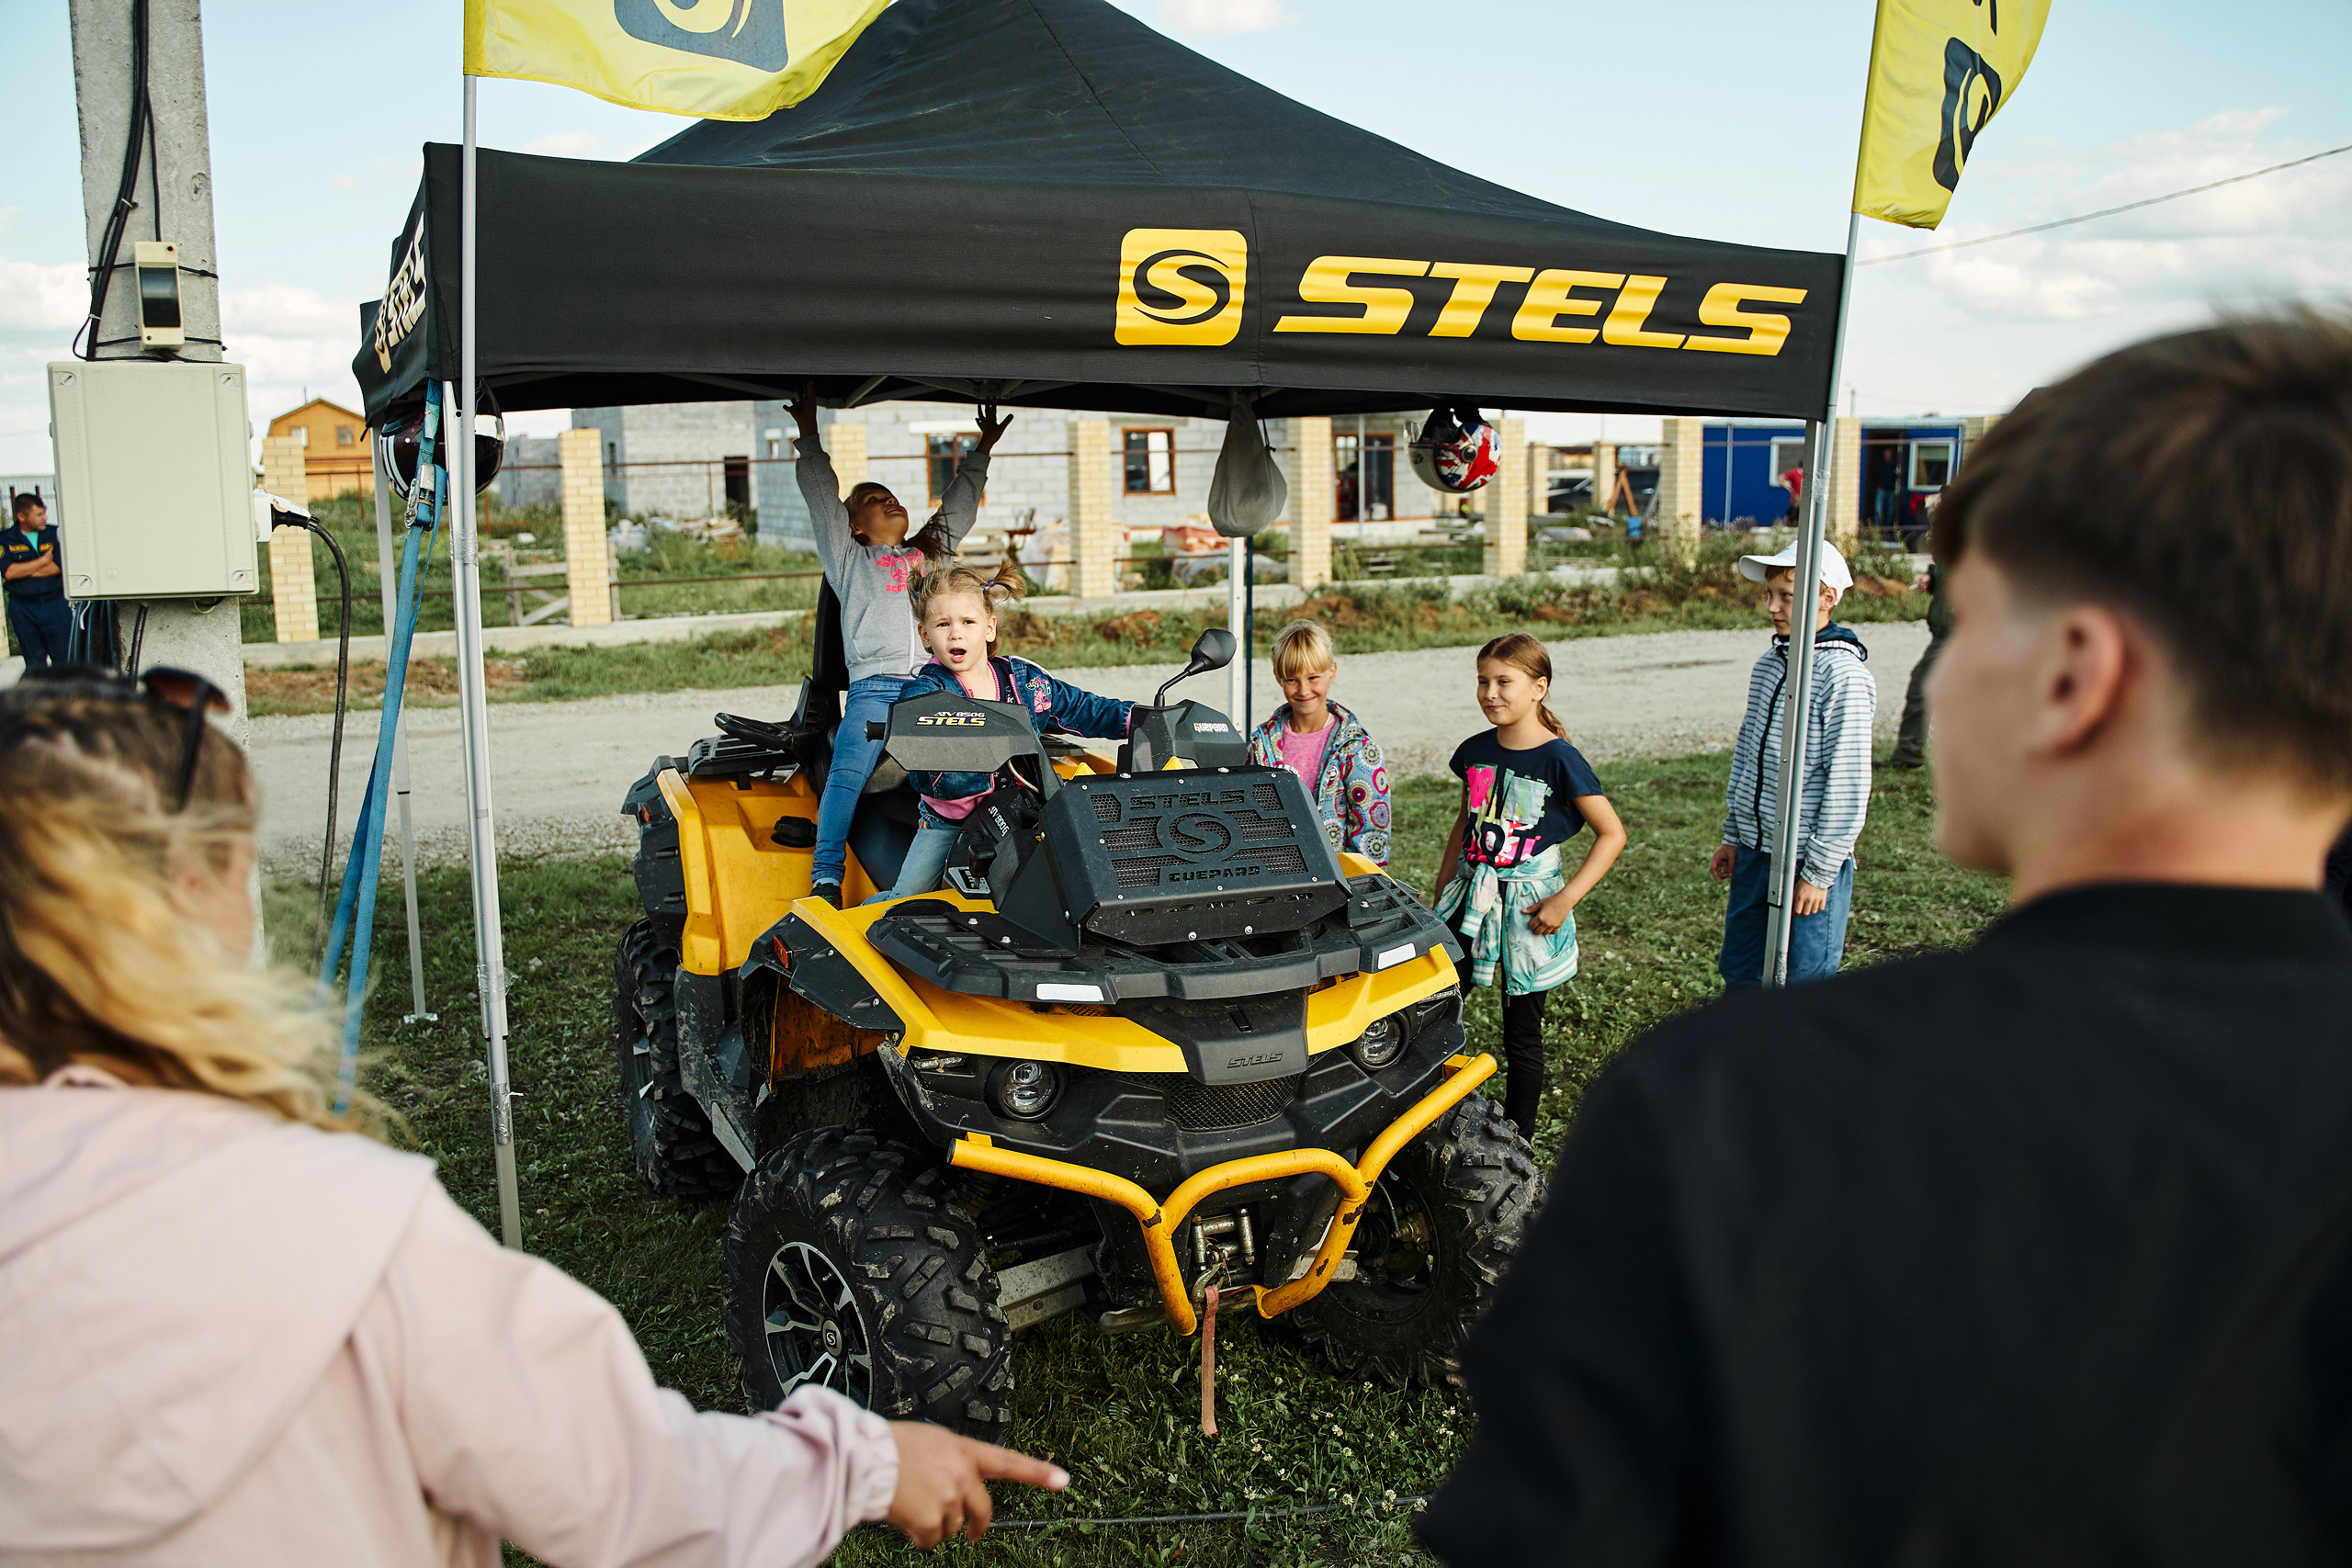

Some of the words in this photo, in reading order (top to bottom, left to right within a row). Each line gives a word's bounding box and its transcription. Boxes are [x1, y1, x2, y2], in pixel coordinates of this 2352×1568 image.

[1272, 255, 1808, 357] STELS
[916, 716, 987, 727] STELS
[1129, 789, 1245, 811] STELS
[1168, 865, 1261, 883] GUEPARD
[1227, 1051, 1284, 1069] STELS
